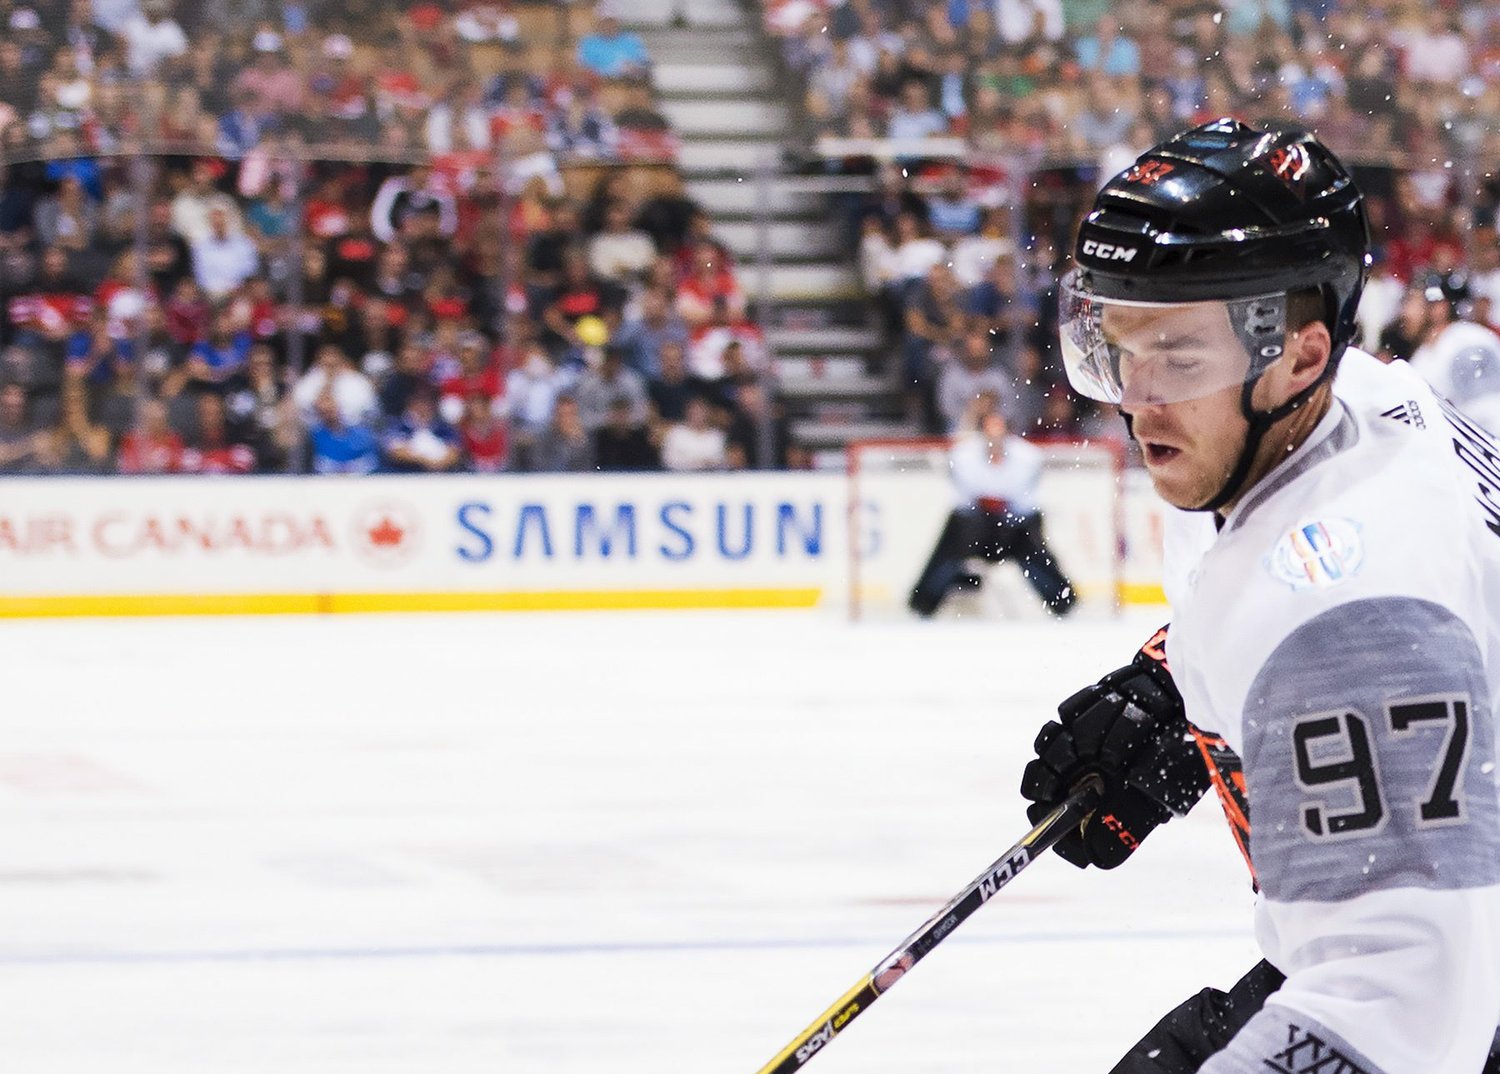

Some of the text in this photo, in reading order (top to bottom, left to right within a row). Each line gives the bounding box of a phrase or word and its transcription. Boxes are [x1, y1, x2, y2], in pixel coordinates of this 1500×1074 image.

[1081, 238, 1138, 263] CCM
[92, 513, 334, 558] CANADA
[455, 499, 883, 563] SAMSUNG
[1292, 691, 1472, 844] 97
[979, 848, 1031, 903] CCM
